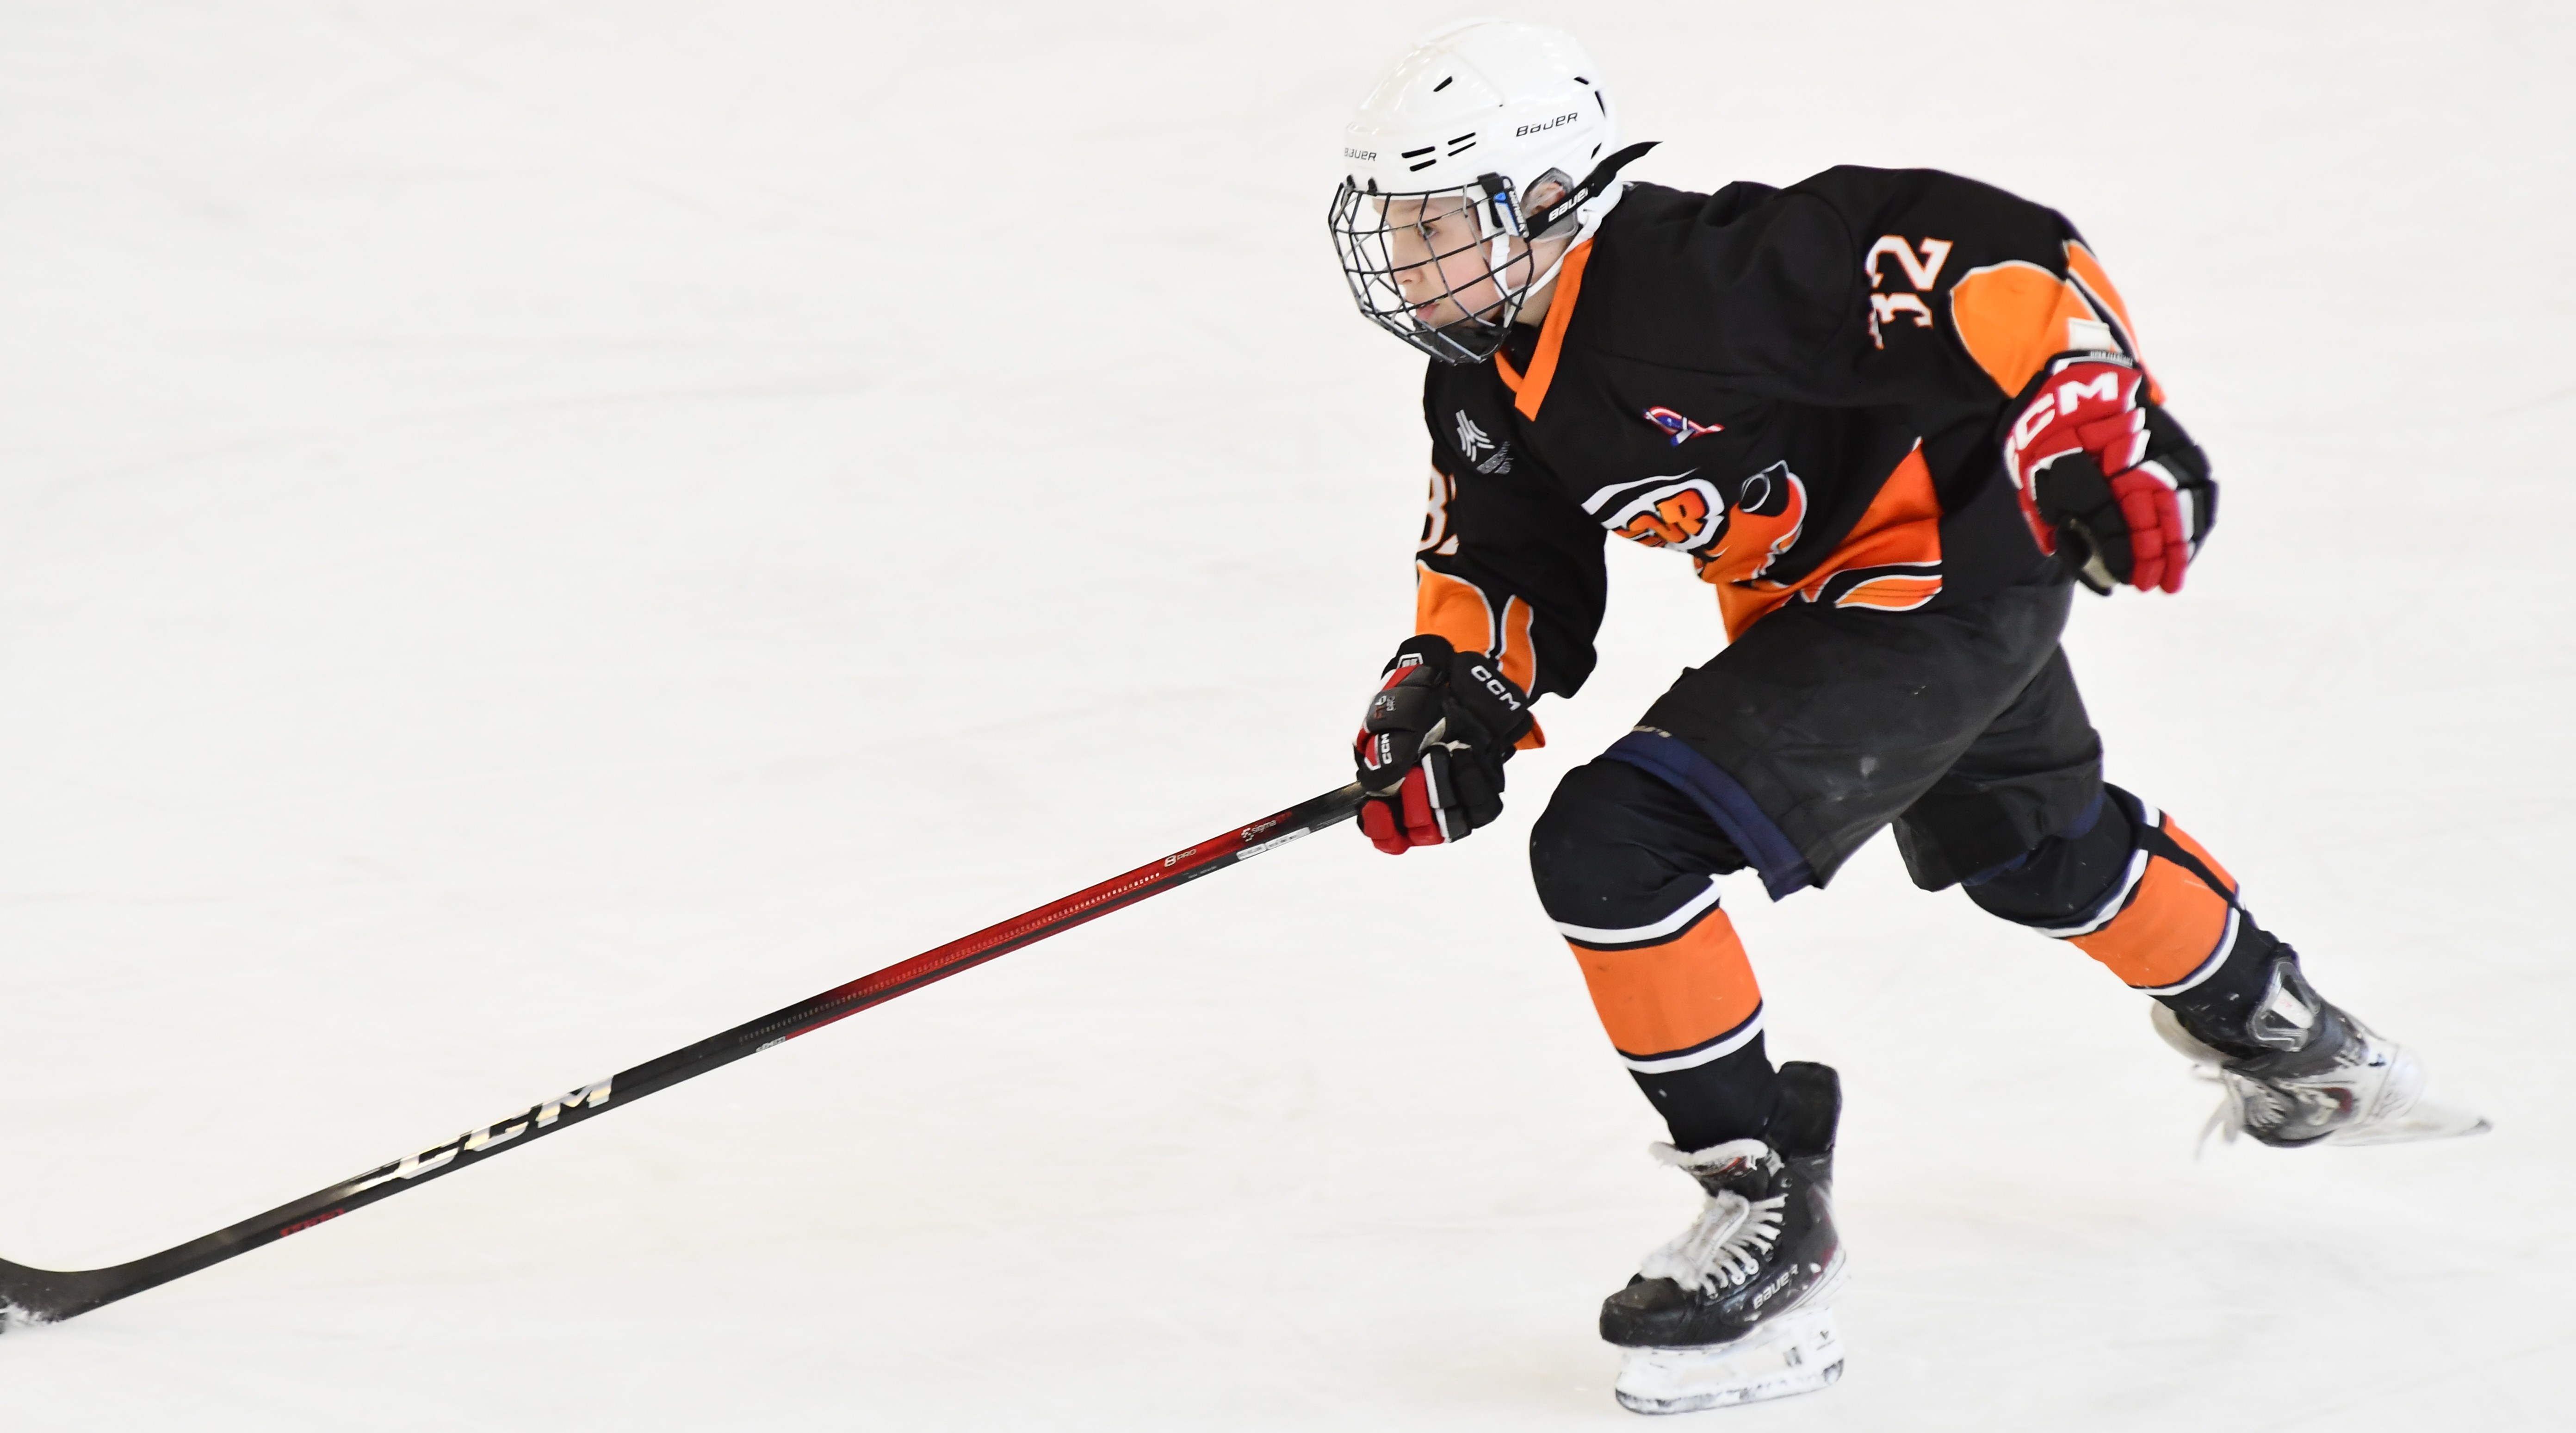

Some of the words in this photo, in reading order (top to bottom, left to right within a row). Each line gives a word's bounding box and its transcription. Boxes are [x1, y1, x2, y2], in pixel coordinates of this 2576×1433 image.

[1516, 112, 1578, 137] BAUER
[1471, 665, 1521, 711] CCM
[1381, 733, 1393, 764] CCM
[396, 1075, 613, 1179] CCM
